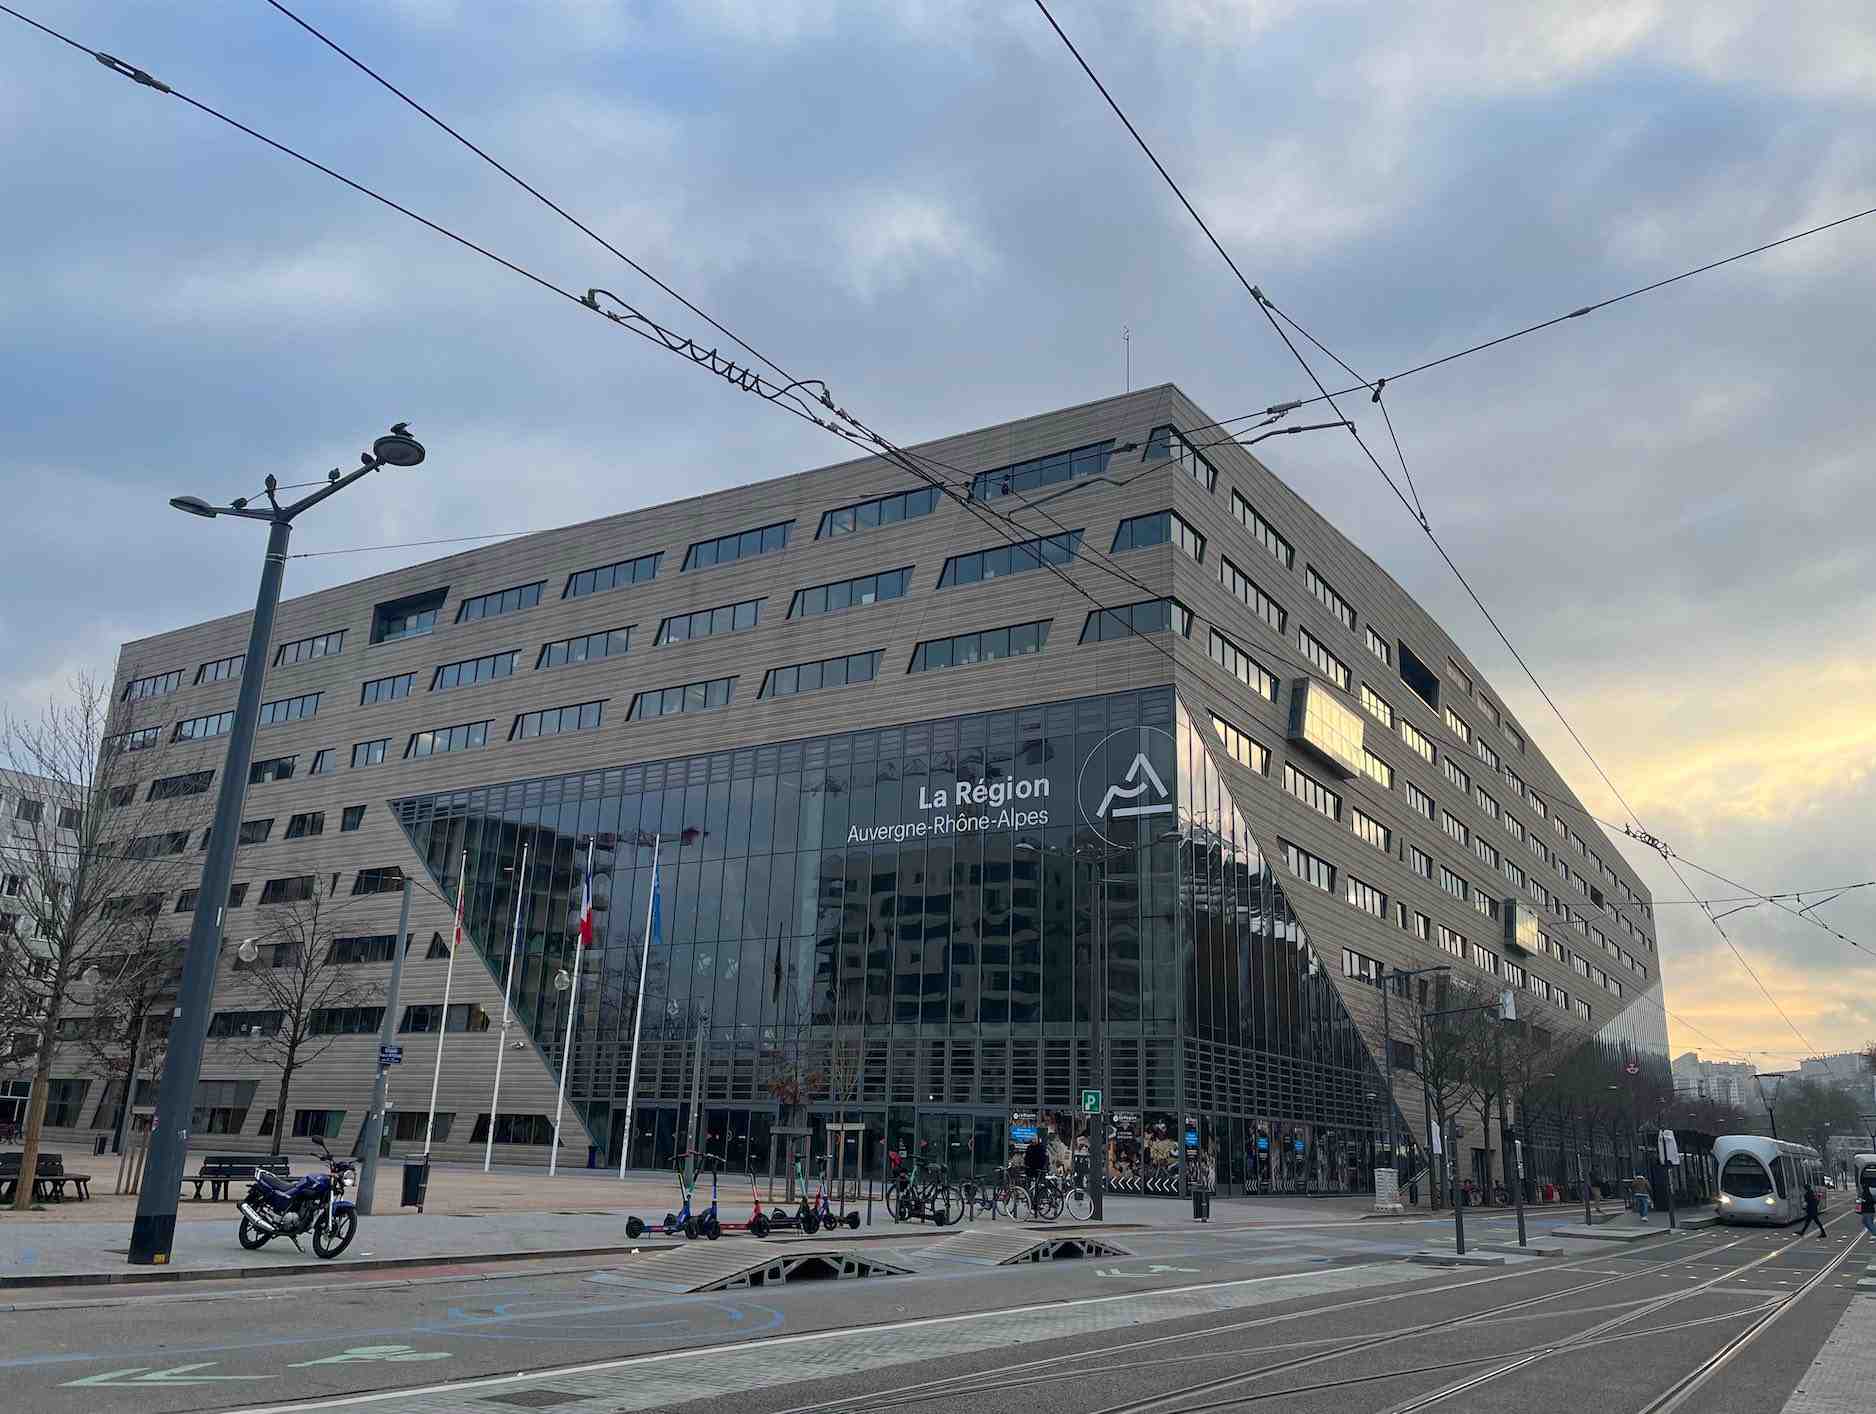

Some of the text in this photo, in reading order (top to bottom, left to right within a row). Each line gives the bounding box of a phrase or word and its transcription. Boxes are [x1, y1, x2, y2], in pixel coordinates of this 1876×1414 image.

[919, 775, 1050, 809] La Région
[847, 808, 1049, 843] Auvergne-Rhône-Alpes
